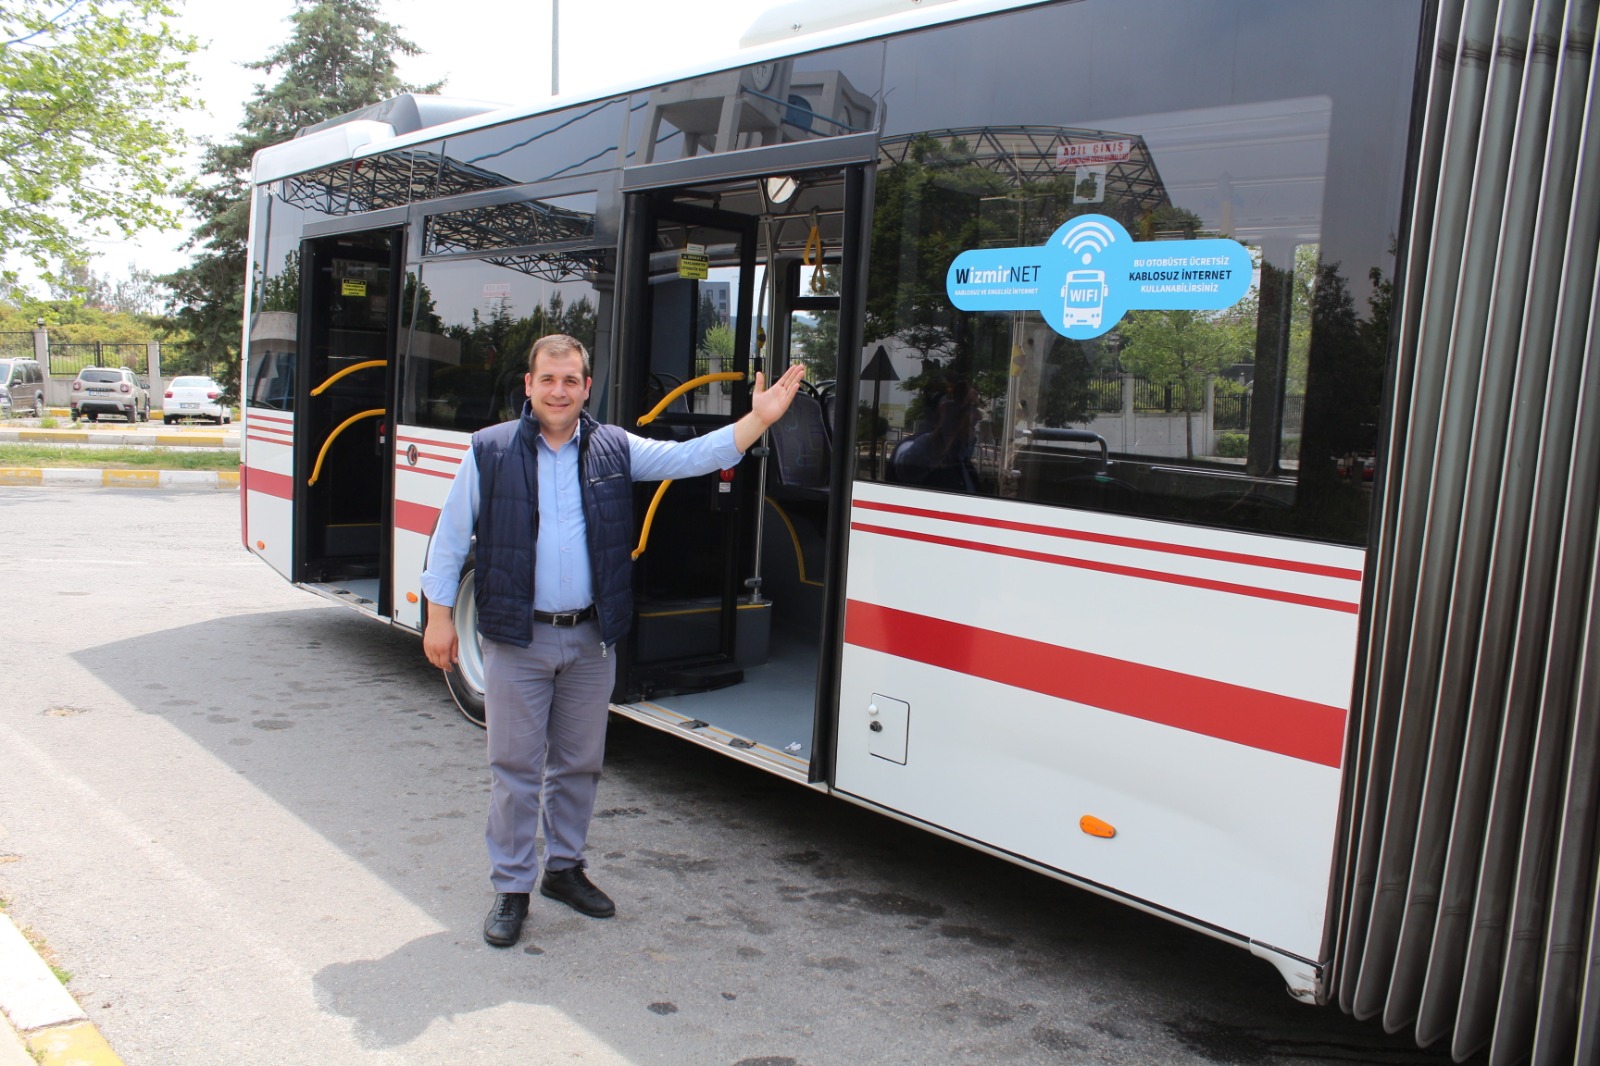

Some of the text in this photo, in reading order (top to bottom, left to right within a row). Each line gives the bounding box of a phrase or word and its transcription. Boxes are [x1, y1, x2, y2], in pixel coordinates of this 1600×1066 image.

[1133, 255, 1230, 267] BU OTOBÜSTE ÜCRETSİZ
[956, 265, 1041, 284] WizmirNET
[1129, 268, 1232, 281] KABLOSUZ İNTERNET
[1141, 283, 1218, 293] KULLANABİLİRSİNİZ
[1070, 289, 1098, 302] WIFI
